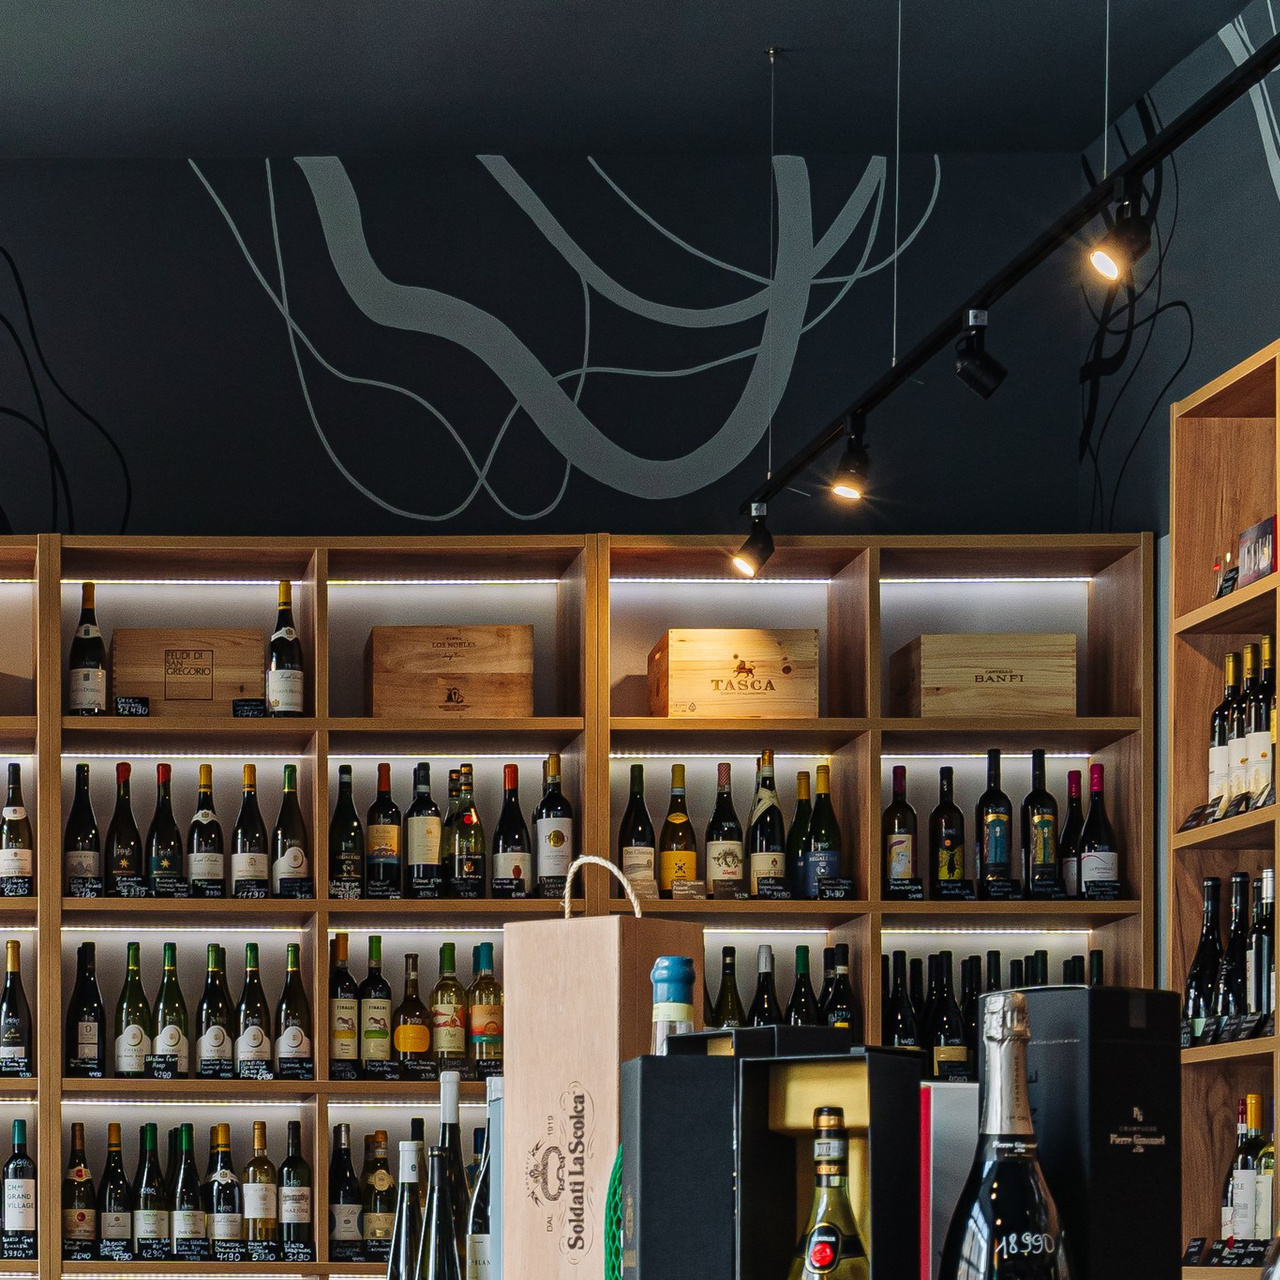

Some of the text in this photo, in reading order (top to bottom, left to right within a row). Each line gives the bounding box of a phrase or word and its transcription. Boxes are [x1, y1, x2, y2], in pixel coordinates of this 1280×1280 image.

[167, 652, 204, 660] FEUDI DI
[166, 667, 211, 676] GREGORIO
[974, 674, 1024, 683] BANFI
[710, 678, 777, 692] TASCA
[823, 890, 845, 899] 3490
[1110, 1134, 1131, 1145] Pierre
[568, 1181, 585, 1251] Soldati
[995, 1232, 1055, 1255] 18990
[217, 1252, 243, 1261] 4190
[286, 1253, 310, 1261] 3190
